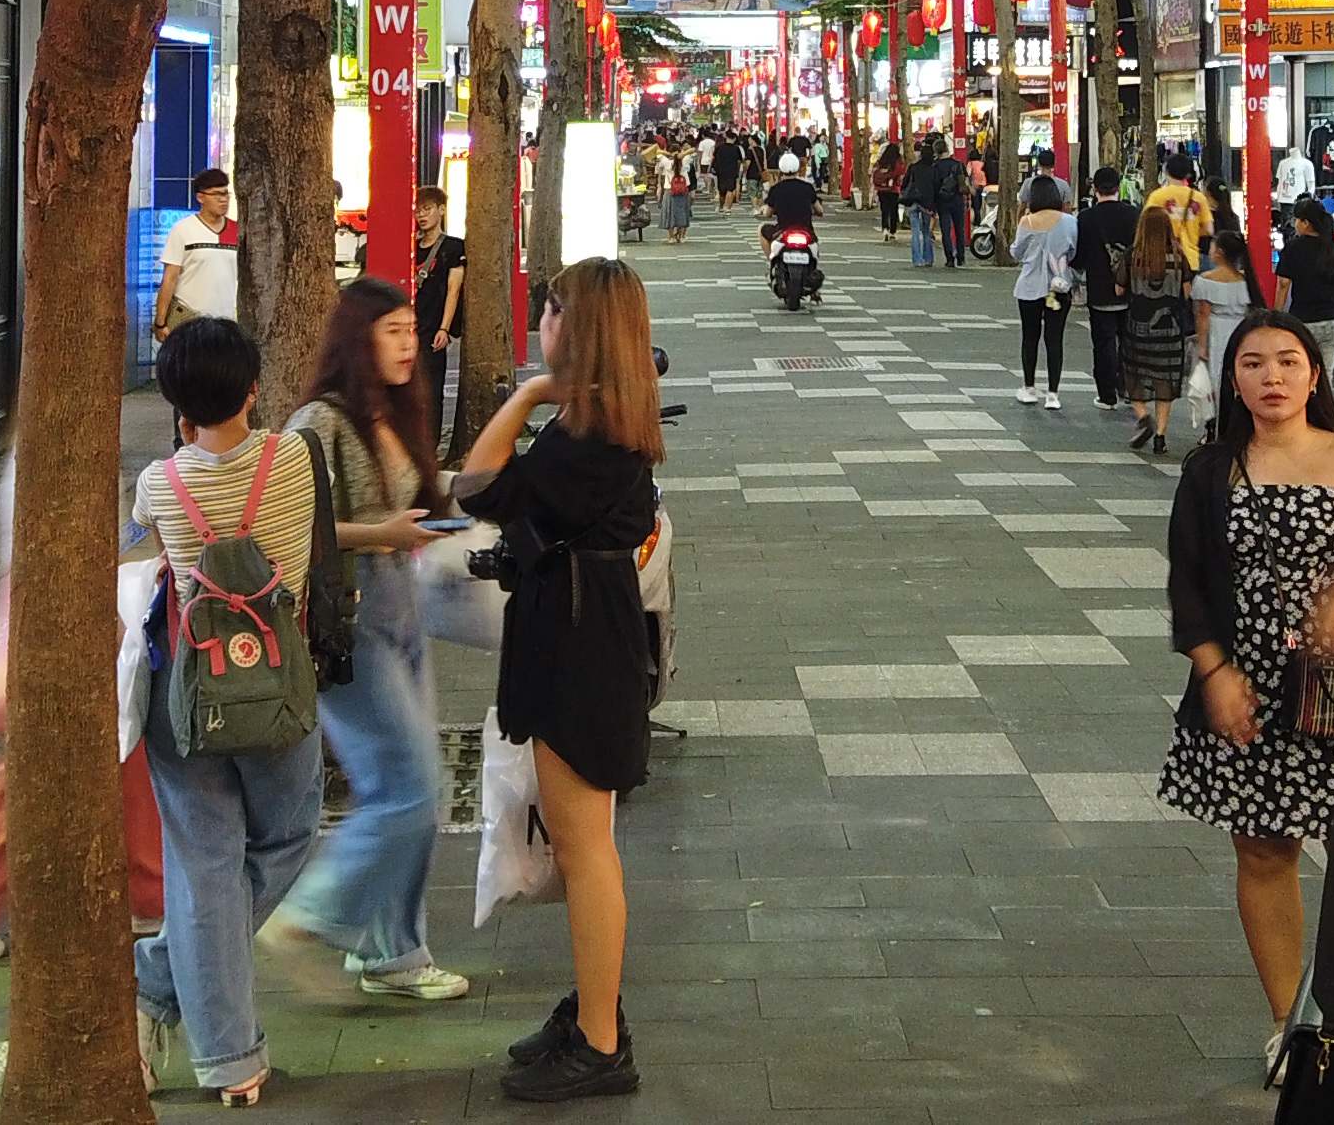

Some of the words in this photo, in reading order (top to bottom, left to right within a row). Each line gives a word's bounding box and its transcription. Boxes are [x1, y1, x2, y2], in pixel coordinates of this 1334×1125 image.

[374, 5, 410, 34] W
[1249, 64, 1267, 80] W
[371, 68, 410, 96] 04
[1053, 81, 1067, 92] W
[955, 90, 966, 98] W
[1053, 103, 1067, 114] 07
[1248, 97, 1267, 112] 05
